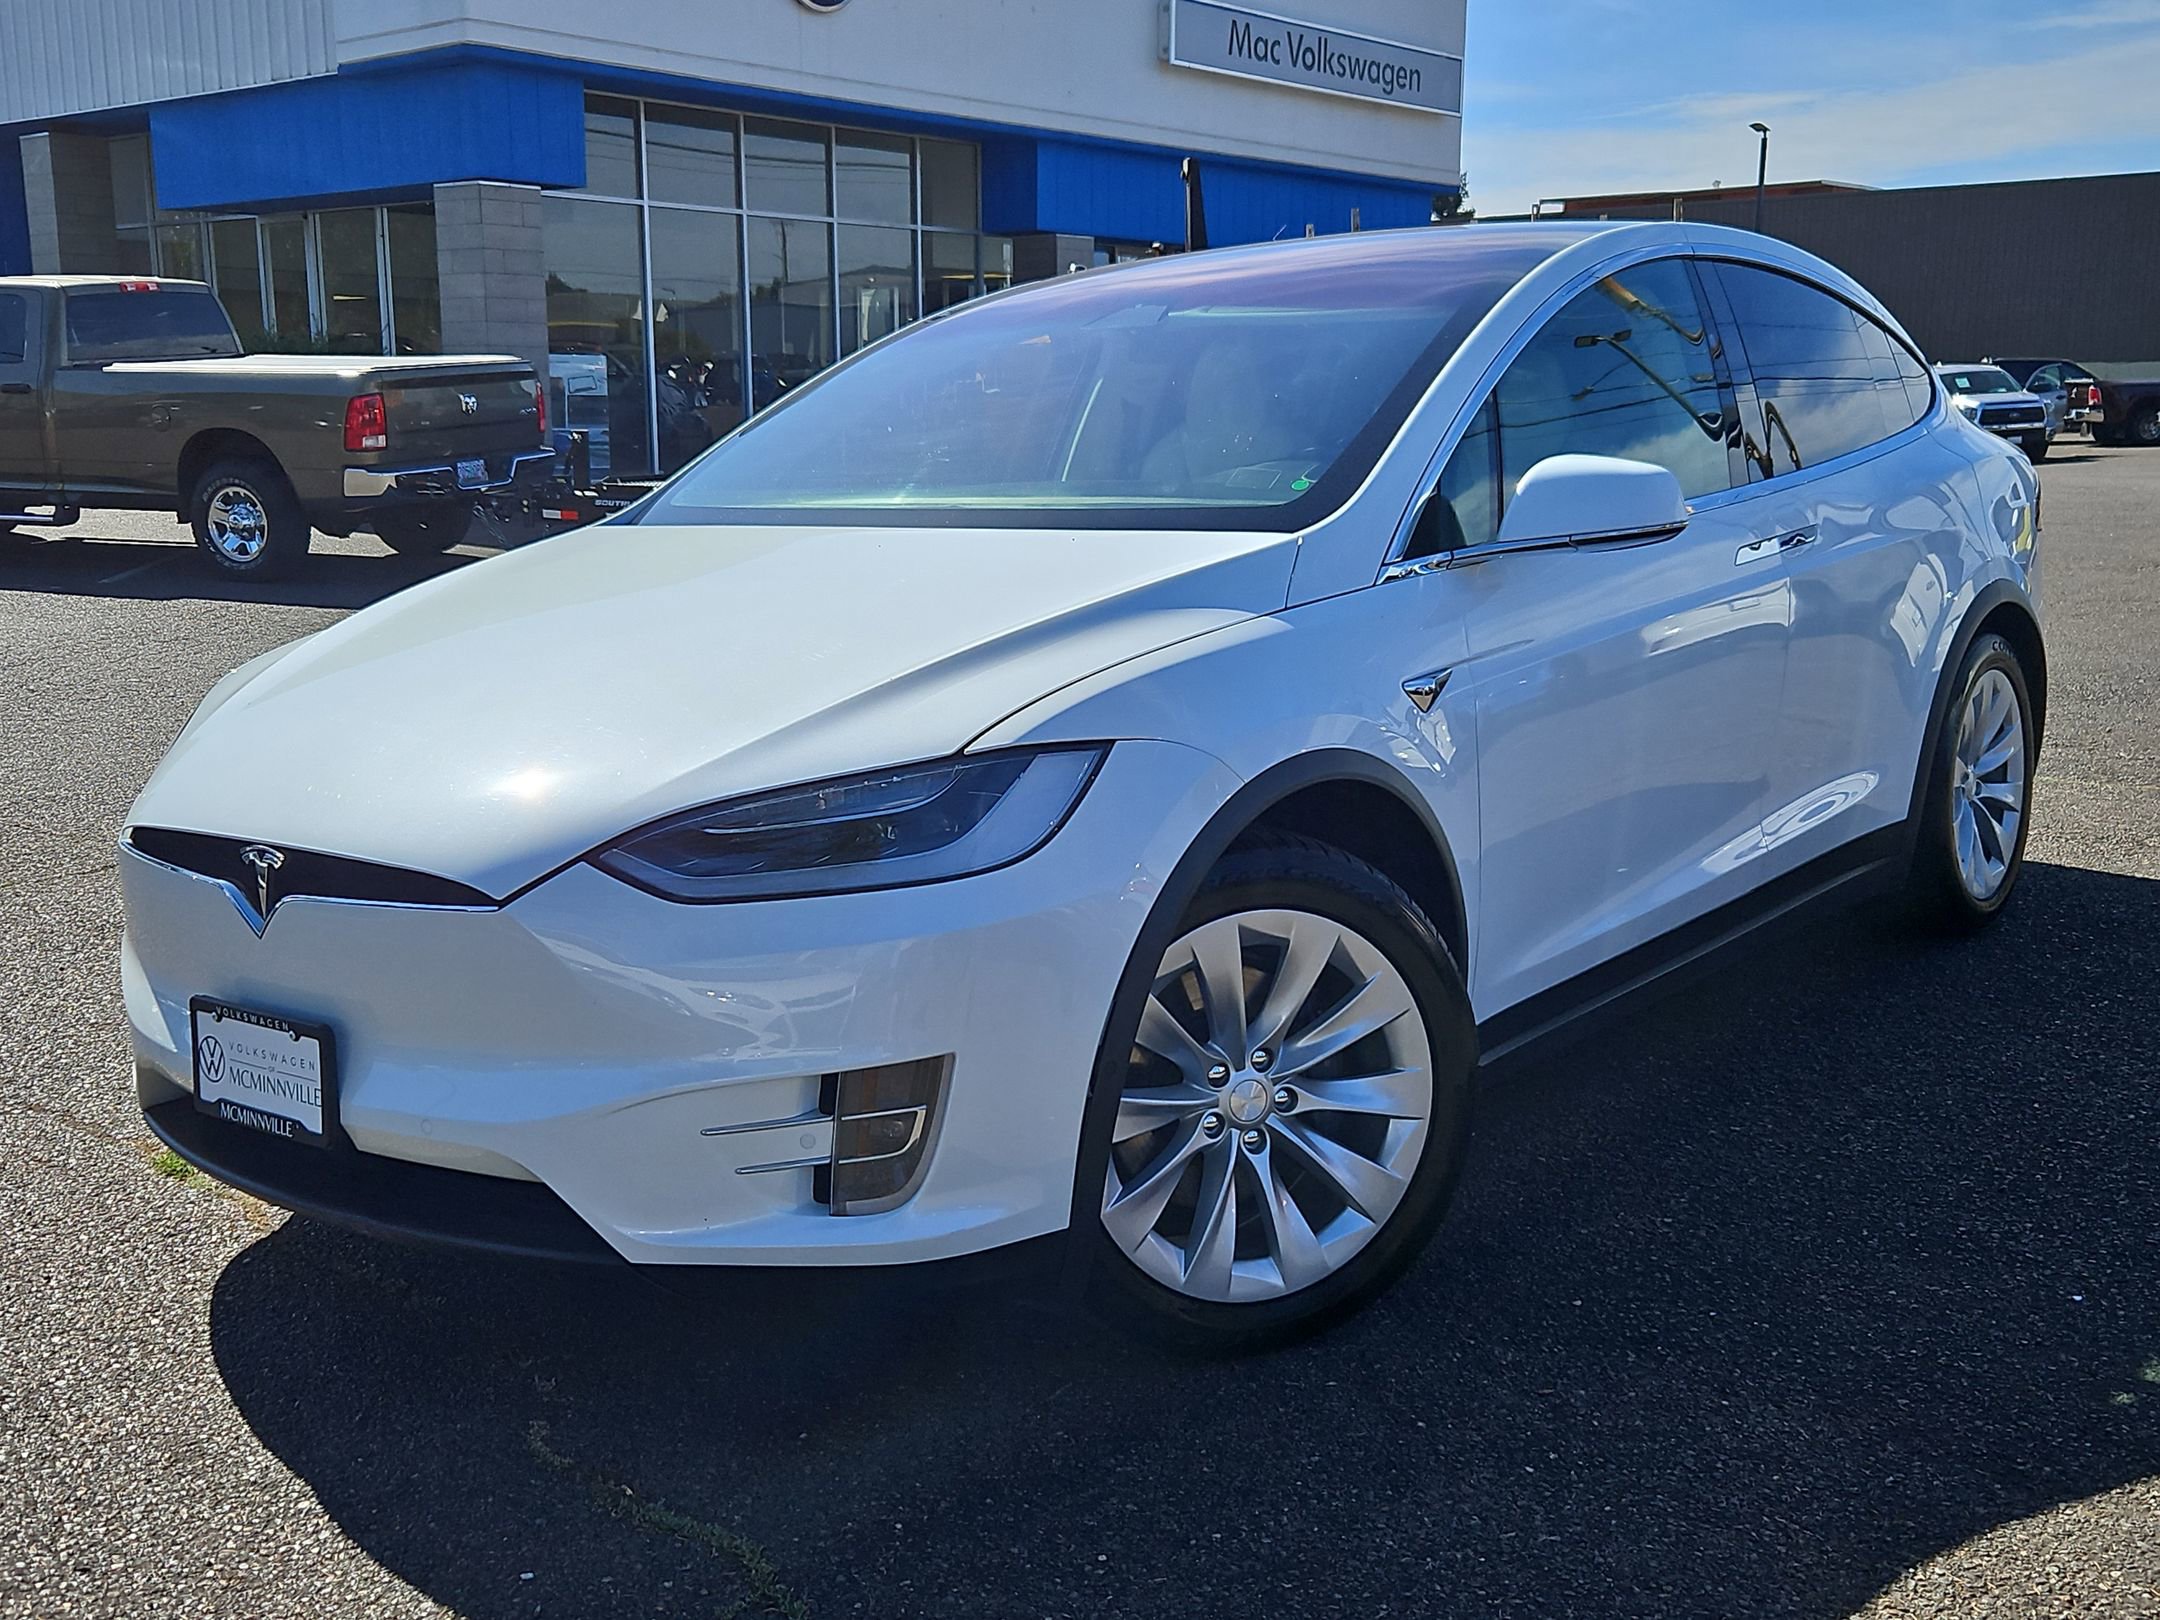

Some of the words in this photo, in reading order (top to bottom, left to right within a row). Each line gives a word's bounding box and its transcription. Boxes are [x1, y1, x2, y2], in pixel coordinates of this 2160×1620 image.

[1227, 19, 1281, 66] Mac
[1286, 31, 1421, 95] Volkswagen
[215, 1005, 290, 1032] VOLKSWAGEN
[229, 1041, 315, 1071] VOLKSWAGEN
[229, 1066, 322, 1108] MCMINNVILLE
[220, 1102, 293, 1137] MCMINNVILLE
